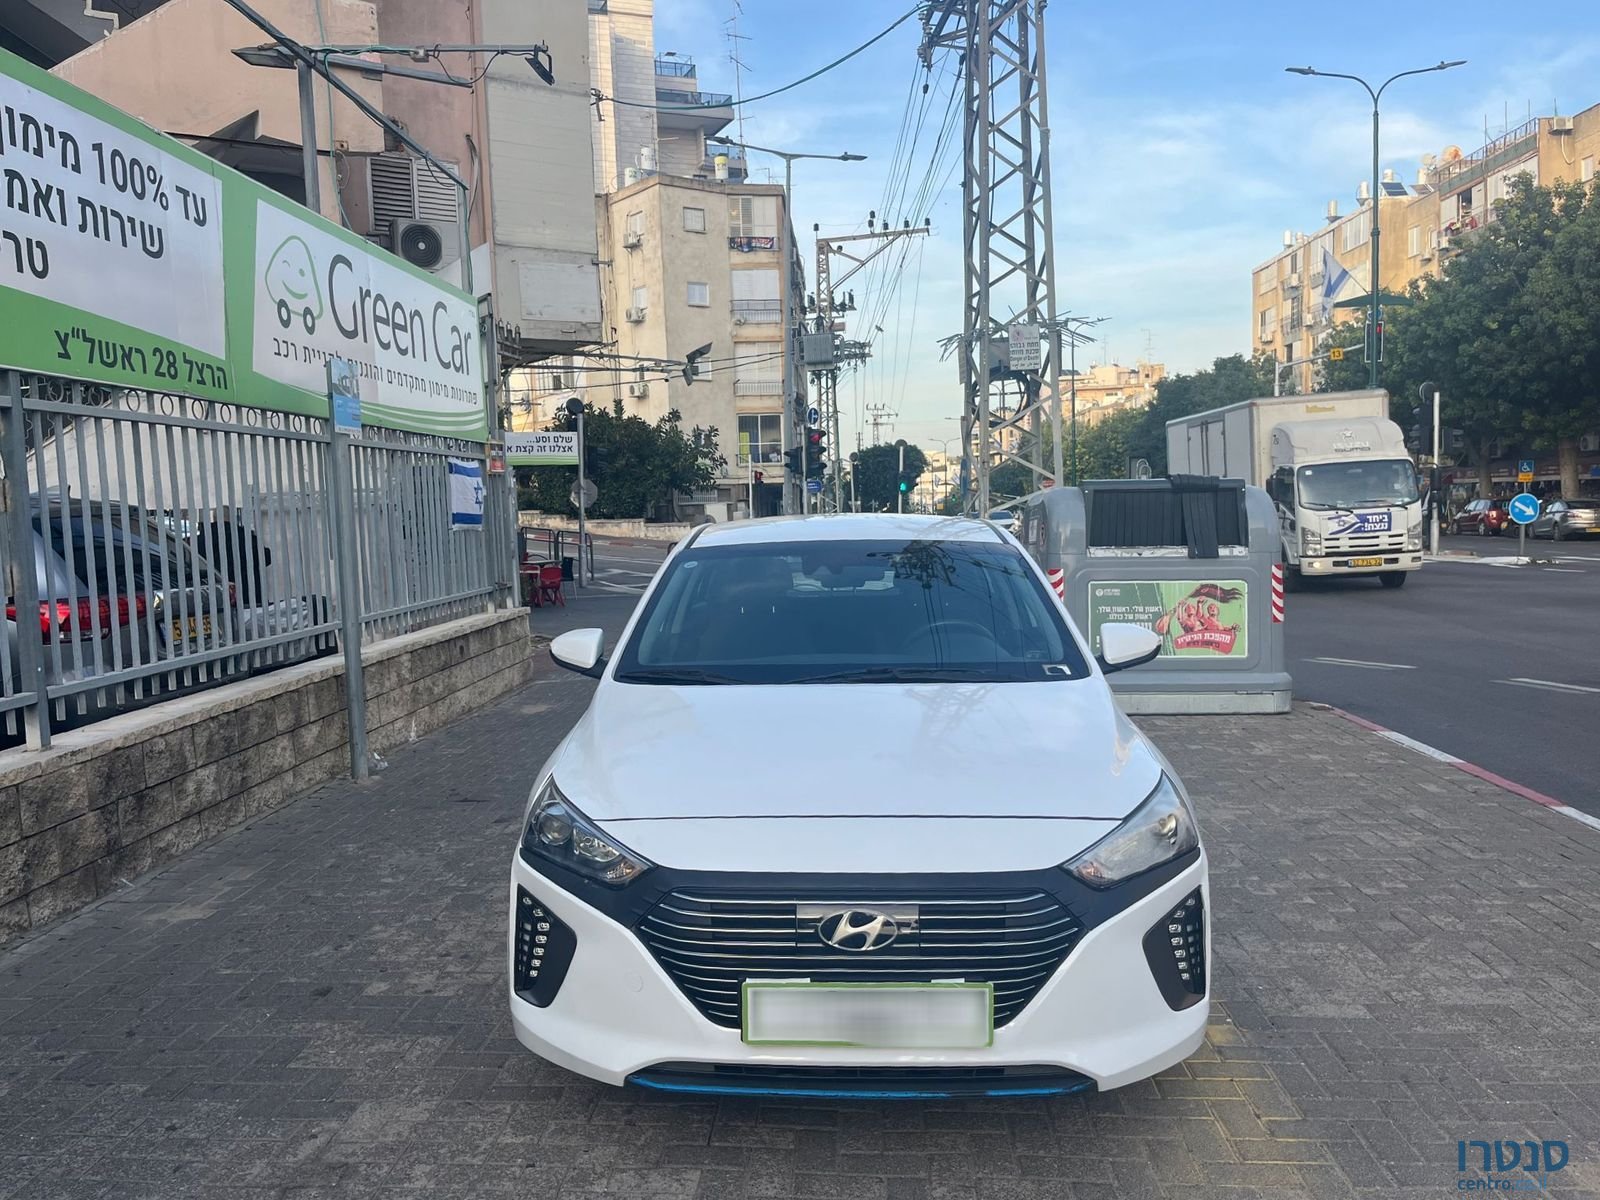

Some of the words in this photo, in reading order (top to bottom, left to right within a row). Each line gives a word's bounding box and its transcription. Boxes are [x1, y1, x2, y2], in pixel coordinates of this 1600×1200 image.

[0, 105, 81, 175] מימו
[92, 142, 169, 211] 100%
[175, 185, 207, 227] עד
[77, 196, 164, 259] שירות
[0, 230, 49, 279] טר
[328, 254, 427, 362] Green
[432, 301, 472, 376] Car
[273, 337, 298, 361] רכב
[1332, 350, 1341, 358] 13
[152, 347, 178, 380] 28
[182, 352, 228, 390] הרצל
[387, 369, 426, 394] מתקדמים
[429, 380, 449, 398] מימון
[451, 386, 477, 405] פתרונות
[515, 445, 534, 454] קצת
[537, 445, 547, 453] זה
[549, 444, 573, 453] אצלנו
[553, 434, 573, 443] שלם
[1364, 522, 1388, 531] ננצח!
[1366, 514, 1389, 523] ביחד
